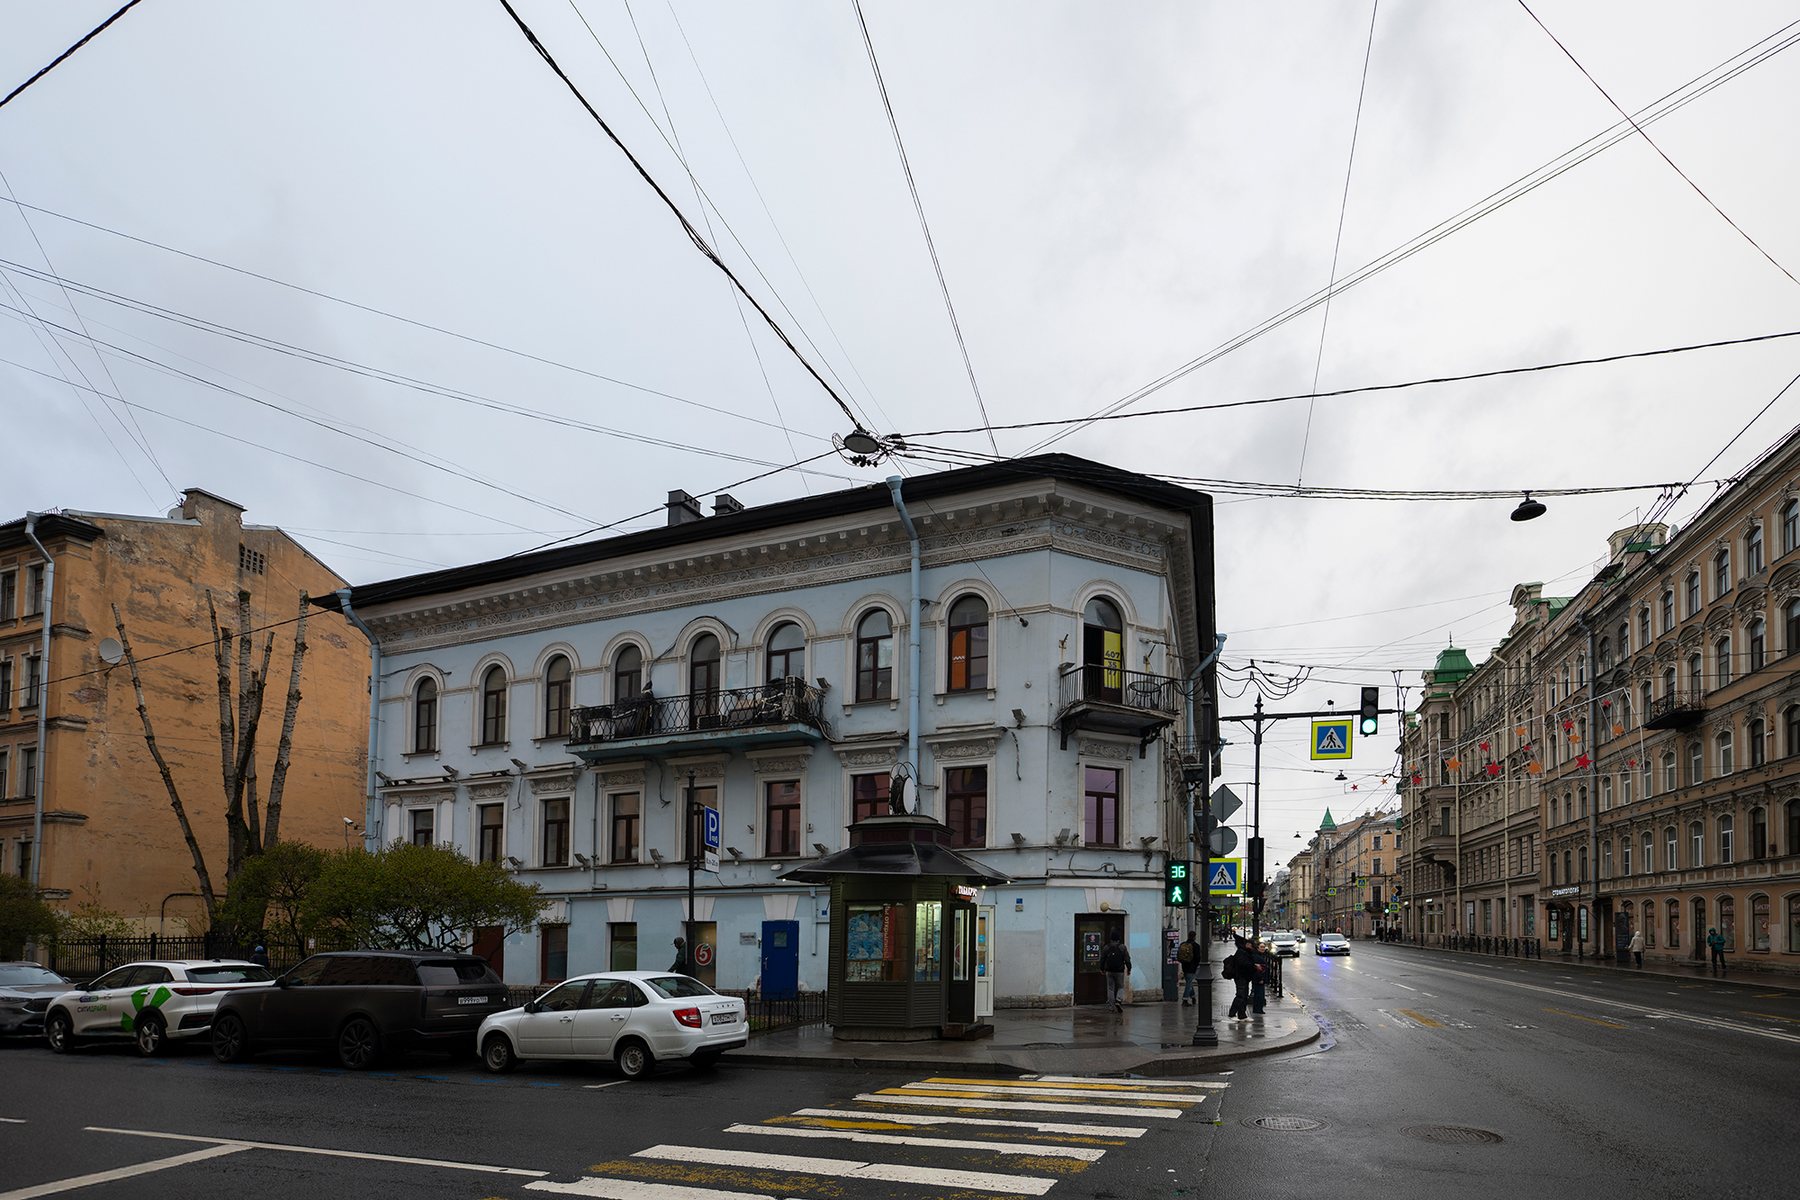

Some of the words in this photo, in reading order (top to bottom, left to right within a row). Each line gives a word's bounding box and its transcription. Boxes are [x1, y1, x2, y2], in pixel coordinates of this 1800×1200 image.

[1105, 650, 1120, 658] 407
[1108, 661, 1117, 670] 35
[708, 812, 718, 841] P
[1171, 865, 1186, 878] 36
